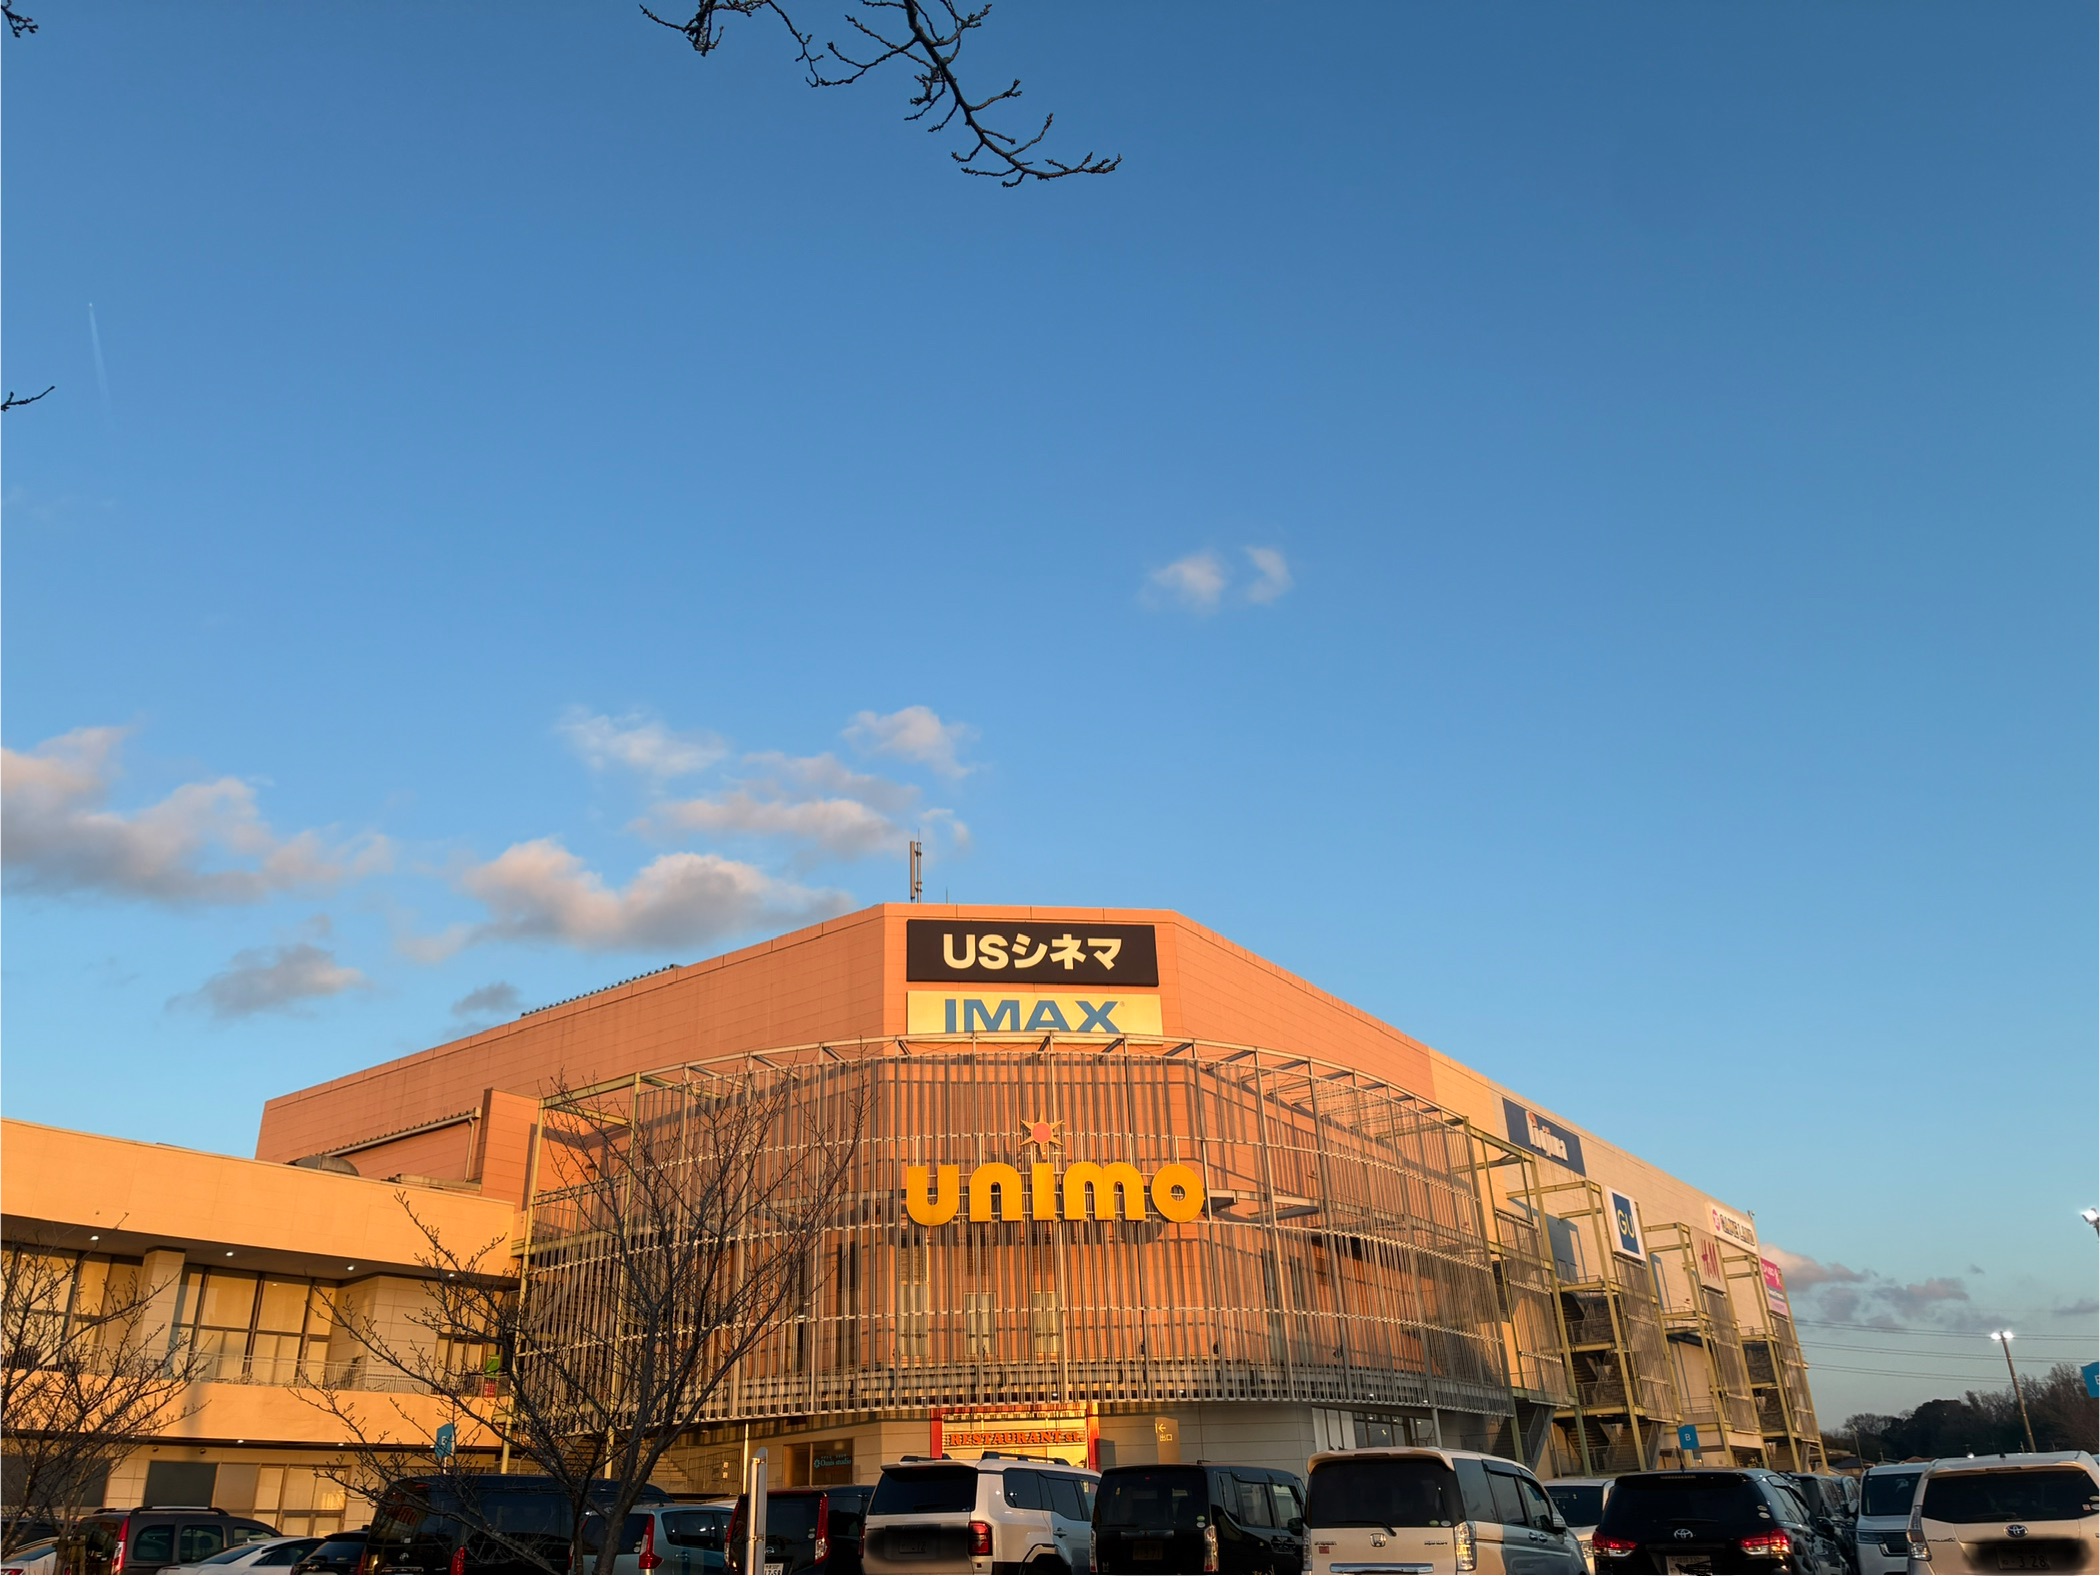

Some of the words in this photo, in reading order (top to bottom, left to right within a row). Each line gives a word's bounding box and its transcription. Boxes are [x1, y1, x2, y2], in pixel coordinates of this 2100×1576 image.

[942, 932, 1123, 971] USシネマ
[944, 998, 1121, 1034] IMAX
[905, 1161, 1205, 1227] unimo
[1617, 1209, 1635, 1239] GU
[949, 1430, 1063, 1446] RESTAURANT
[1159, 1433, 1173, 1442] 出口
